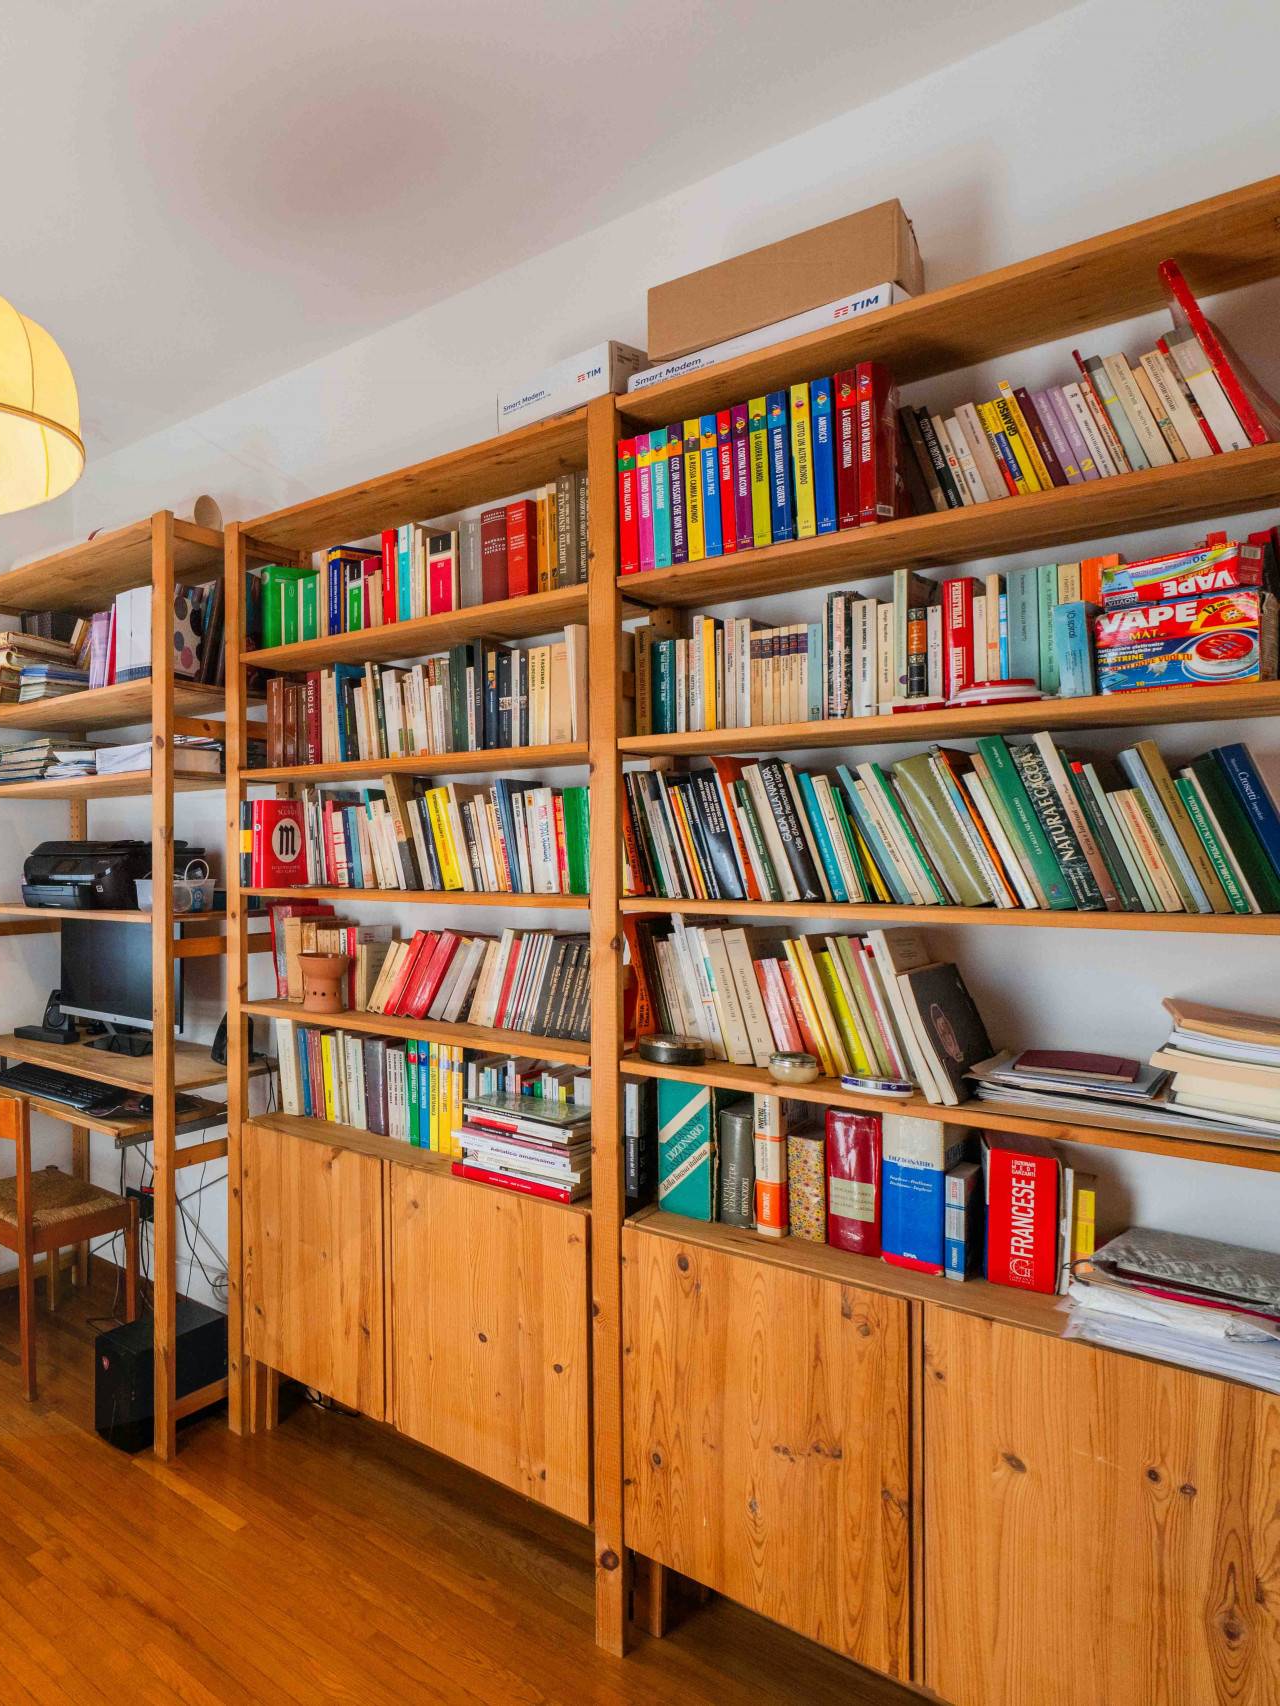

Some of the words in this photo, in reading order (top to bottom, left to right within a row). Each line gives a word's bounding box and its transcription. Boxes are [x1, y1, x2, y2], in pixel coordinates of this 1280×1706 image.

[851, 295, 880, 312] TIM
[586, 367, 601, 379] TIM
[634, 370, 662, 387] Smart
[665, 357, 702, 376] Modem
[502, 399, 523, 412] Smart
[521, 388, 546, 404] Modem
[841, 408, 850, 416] LA
[859, 399, 870, 421] RUSSIA
[995, 398, 1018, 438] GRAMSCI
[752, 432, 761, 440] LA
[796, 419, 806, 437] TUTTO
[840, 416, 850, 439] GUERRA
[860, 426, 869, 441] NON
[736, 439, 746, 447] LA
[752, 440, 762, 461] GUERRA
[772, 433, 782, 449] MARE
[797, 437, 806, 446] UN
[688, 453, 695, 461] LA
[720, 451, 730, 465] CASO
[736, 446, 746, 469] CORTINA
[797, 446, 807, 464] ALTRO
[840, 439, 852, 469] CONTINUA
[860, 441, 870, 463] RUSSIA
[687, 460, 696, 479] RUSSIA
[753, 461, 763, 483] GRANDE
[798, 464, 808, 485] MONDO
[1066, 465, 1079, 477] 1
[1080, 458, 1095, 472] 2
[622, 477, 632, 493] TURCO
[639, 473, 649, 492] REGNO
[671, 471, 680, 480] UN
[705, 468, 714, 484] DELLA
[623, 493, 632, 505] ALLA
[671, 480, 681, 505] PASSATO
[706, 483, 715, 496] PACE
[775, 485, 785, 507] GUERRA
[558, 491, 566, 532] SINDACALE
[622, 505, 632, 522] PORTA
[672, 504, 682, 516] CHE
[689, 504, 697, 524] MONDO
[673, 515, 682, 528] NON
[673, 528, 683, 547] PASSA
[558, 533, 567, 563] DIRITTO
[1191, 552, 1207, 563] 30
[559, 565, 567, 574] IL
[1161, 569, 1235, 597] VAPE
[1100, 602, 1198, 634] VAPE
[1129, 630, 1157, 641] MAT
[760, 765, 777, 796] NATURA
[769, 762, 784, 783] Liguria
[1019, 750, 1050, 801] CACCIA
[1236, 769, 1260, 803] Crosetti
[770, 795, 783, 816] ALLA
[778, 787, 793, 814] Piemonte
[1039, 796, 1054, 809] E
[1187, 793, 1210, 833] LOMBARDIA
[393, 819, 403, 836] CHE
[777, 816, 793, 842] GUIDA
[1043, 804, 1077, 863] NATURA
[1204, 829, 1214, 840] IN
[794, 835, 805, 850] Valle
[1208, 837, 1223, 859] PESCA
[1217, 857, 1232, 880] DELLA
[1226, 877, 1241, 899] LIBRO
[1235, 896, 1245, 906] IL
[663, 1122, 708, 1162] DIZIONARIO
[660, 1176, 676, 1192] della
[685, 1147, 709, 1169] italiana
[888, 1155, 934, 1168] DIZIONARIO
[739, 1177, 750, 1217] DIZIONARIO
[1012, 1177, 1034, 1257] FRANCESE
